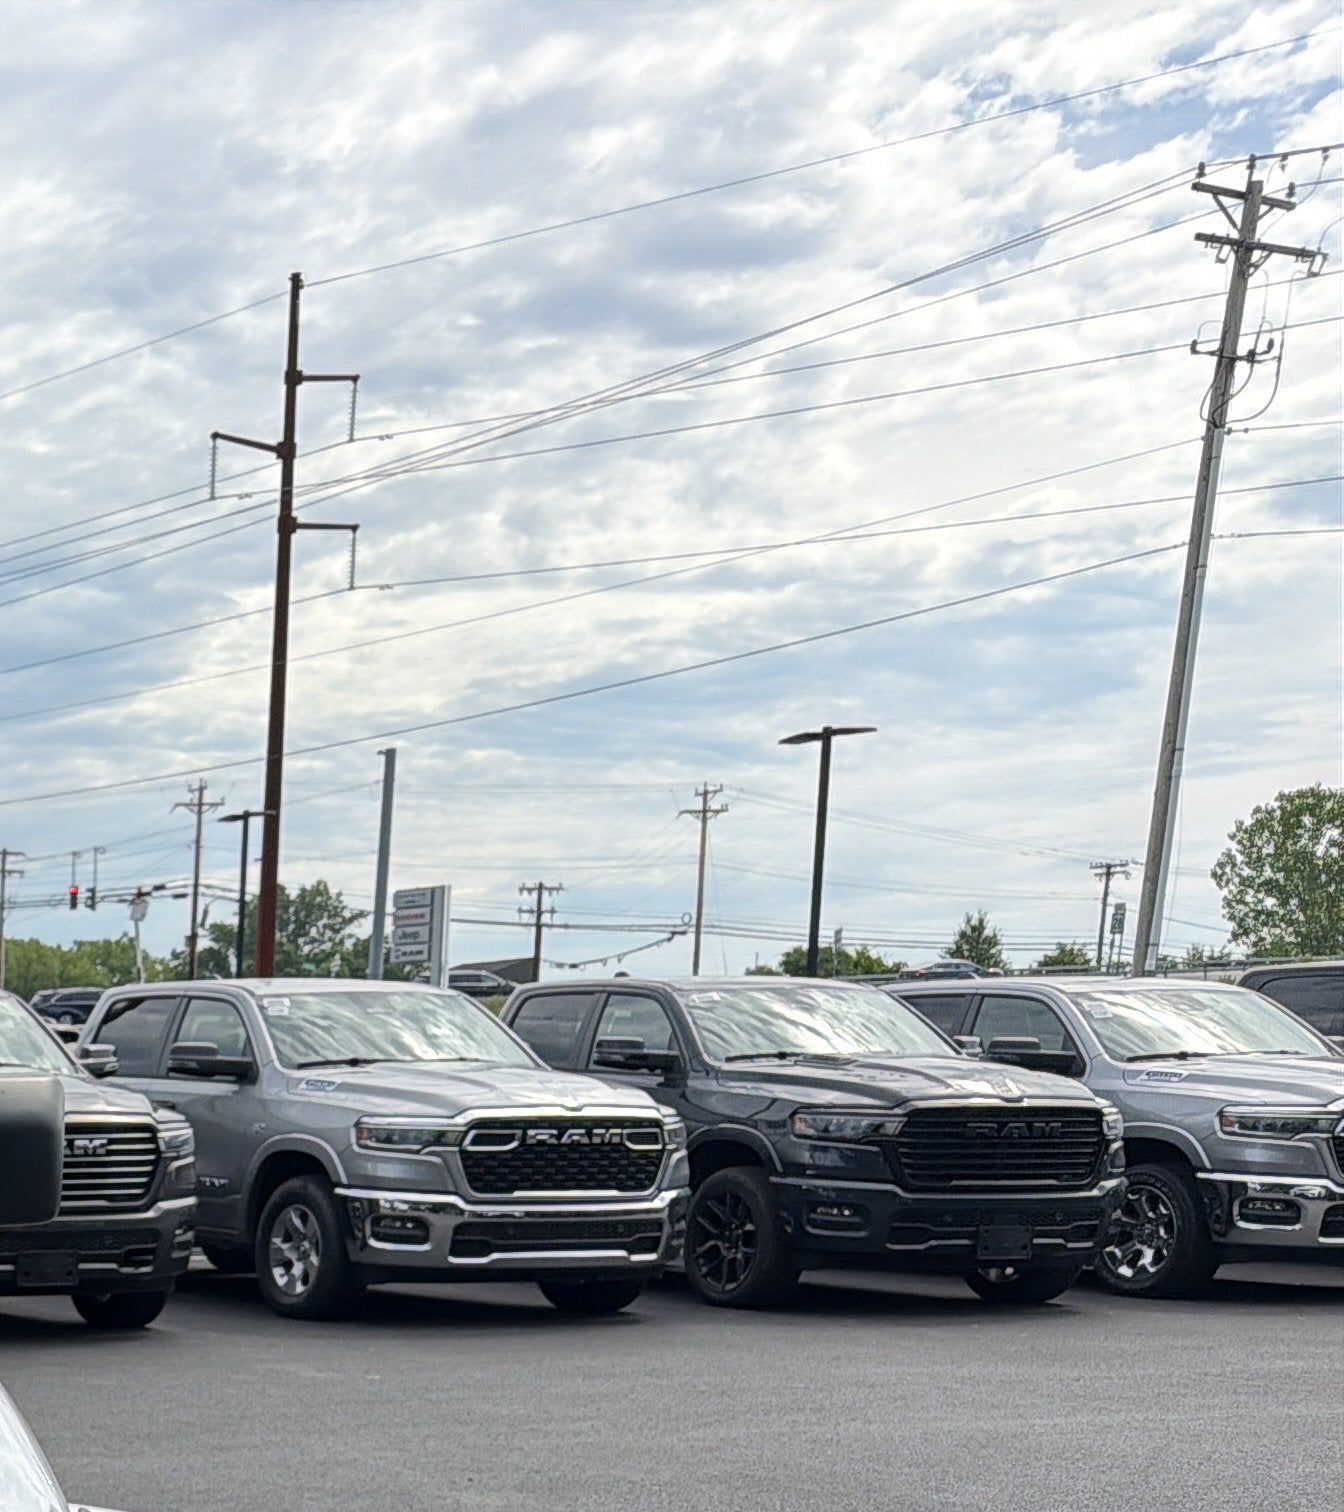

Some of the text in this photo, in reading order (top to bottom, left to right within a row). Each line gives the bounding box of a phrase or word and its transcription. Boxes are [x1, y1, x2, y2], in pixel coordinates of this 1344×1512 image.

[398, 930, 419, 941] Jeep
[526, 1128, 622, 1144] RAM
[967, 1122, 1062, 1137] RAM
